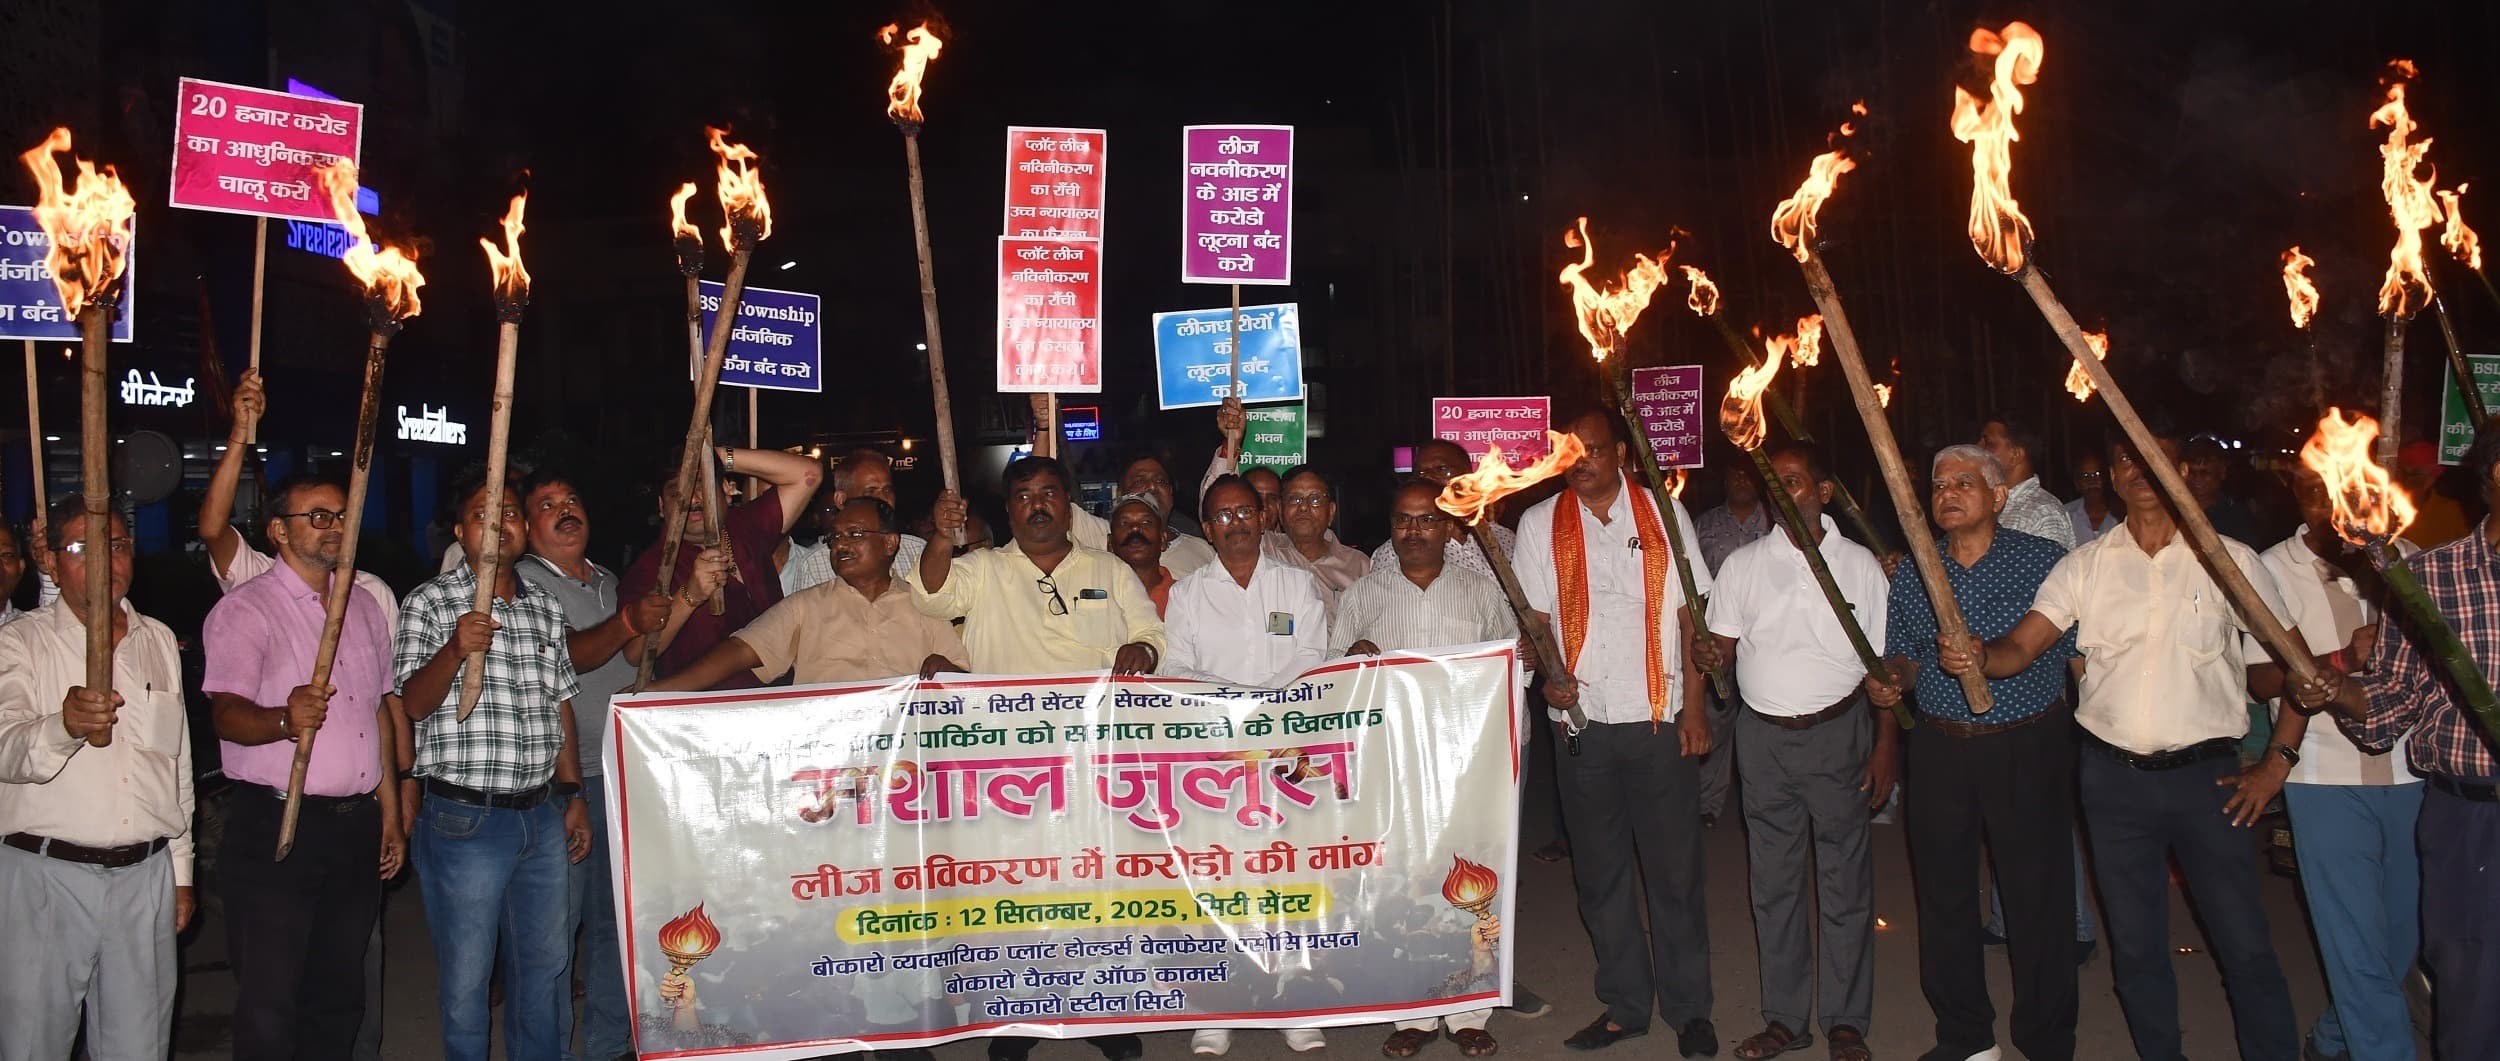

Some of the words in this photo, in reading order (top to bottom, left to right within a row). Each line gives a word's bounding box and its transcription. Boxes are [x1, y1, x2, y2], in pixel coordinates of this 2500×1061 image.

[191, 94, 227, 119] 20
[234, 104, 290, 128] हजार
[293, 112, 350, 136] करोड
[187, 135, 220, 154] का
[1025, 137, 1058, 151] प्लॉट
[1218, 135, 1260, 155] लीज
[1019, 158, 1094, 175] नविनीकरण
[1189, 159, 1287, 179] नवनीकरण
[218, 175, 268, 202] चालू
[270, 181, 311, 201] करो
[1030, 184, 1050, 196] का
[1196, 182, 1217, 201] के
[1221, 187, 1260, 203] आड
[1262, 183, 1283, 203] में
[1010, 206, 1036, 218] उच्च
[1039, 207, 1099, 220] न्यायालय
[1210, 206, 1265, 226] करोडो
[1198, 232, 1249, 254] लूटना
[1253, 229, 1282, 249] बंद
[1017, 246, 1050, 260] प्लॉट
[1053, 246, 1084, 261] लीज
[1217, 253, 1255, 272] करो
[1011, 268, 1089, 284] नविनीकरण
[21, 299, 62, 323] बंद
[753, 357, 778, 375] बंद
[780, 362, 812, 378] करो
[1241, 356, 1270, 374] बंद
[1654, 374, 1680, 387] लीज
[1635, 388, 1698, 402] नवनीकरण
[1441, 406, 1463, 419] 20
[1467, 409, 1503, 420] हजार
[1505, 406, 1542, 419] करोड
[1640, 404, 1654, 417] के
[1656, 406, 1680, 417] आड
[1682, 401, 1696, 415] में
[398, 403, 466, 445] Sreeleathers
[2446, 422, 2466, 435] की
[1254, 433, 1284, 443] भवन
[1441, 431, 1460, 441] का
[1464, 428, 1541, 444] आधुनिकरण
[1255, 453, 1302, 466] मनमानी
[988, 692, 1036, 713] सिटी
[1042, 691, 1086, 711] सेंटर
[1114, 688, 1173, 708] सेक्टर
[915, 722, 1008, 750] पार्किंग
[1016, 720, 1056, 745] को
[1243, 713, 1275, 738] के
[1281, 707, 1384, 736] खिलाफ
[792, 756, 1074, 825] मशाल
[1092, 741, 1354, 831] जुलूस
[791, 864, 883, 900] लीज
[893, 855, 1061, 891] नविकरण
[1071, 846, 1105, 880] में
[1244, 841, 1298, 874] की
[1307, 835, 1385, 870] मांग
[856, 909, 938, 935] दिनांक
[960, 909, 986, 926] 12
[995, 900, 1101, 924] सितम्बर,
[1110, 900, 1188, 922] 2025,
[1257, 890, 1312, 916] सेंटर
[811, 952, 884, 977] बोकारो
[892, 944, 1000, 971] व्यवसायिक
[1006, 941, 1058, 960] प्लांट
[1064, 934, 1133, 958] होल्डर्स
[1139, 933, 1227, 955] वेलफेयर
[946, 968, 1016, 994] बोकारो
[1022, 966, 1085, 989] चैम्बर
[1093, 964, 1147, 986] ऑफ
[1154, 961, 1228, 983] कामर्स
[985, 994, 1062, 1017] बोकारो
[1069, 990, 1127, 1012] स्टील
[1134, 989, 1186, 1011] सिटी
